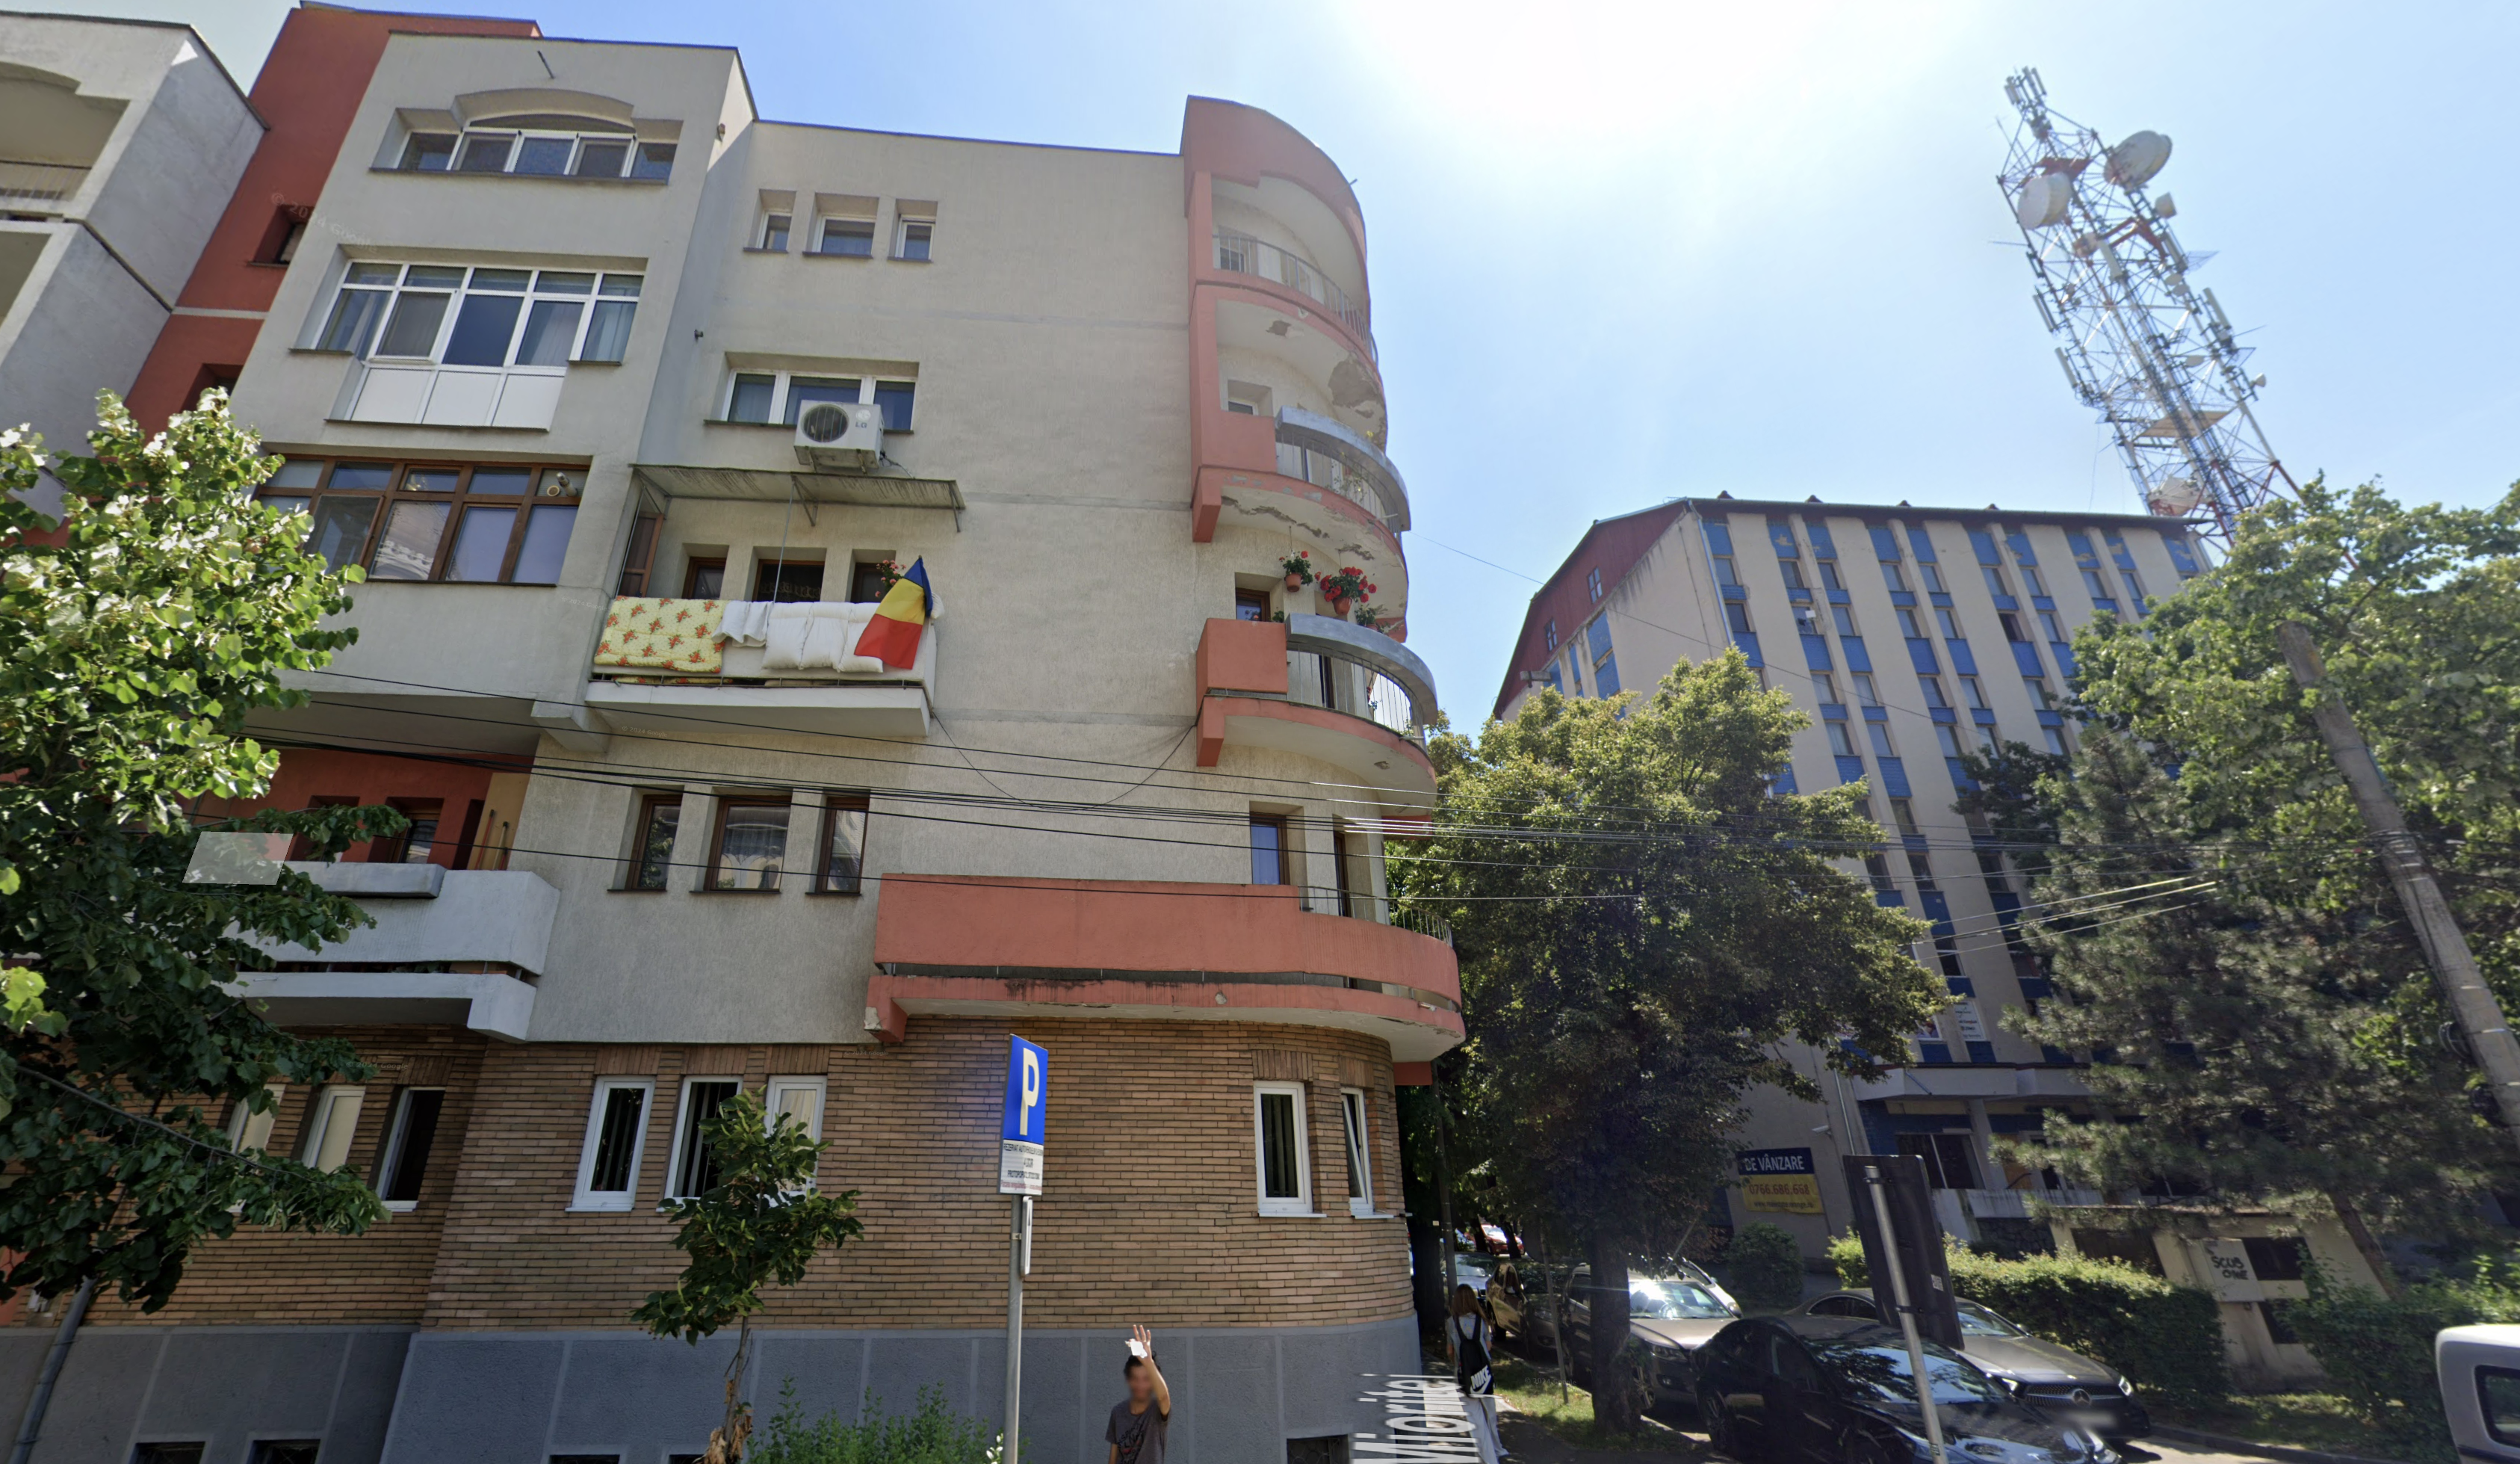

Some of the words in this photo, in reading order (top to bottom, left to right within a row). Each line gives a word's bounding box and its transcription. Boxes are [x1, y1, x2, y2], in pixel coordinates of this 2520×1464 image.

[1019, 1047, 1040, 1136] P
[1745, 1158, 1758, 1172] DE
[1758, 1153, 1805, 1171] VÂNZARE
[1749, 1184, 1810, 1196] 0766.686.668
[2222, 1269, 2249, 1280] ONE
[1471, 1365, 1491, 1389] NIKE
